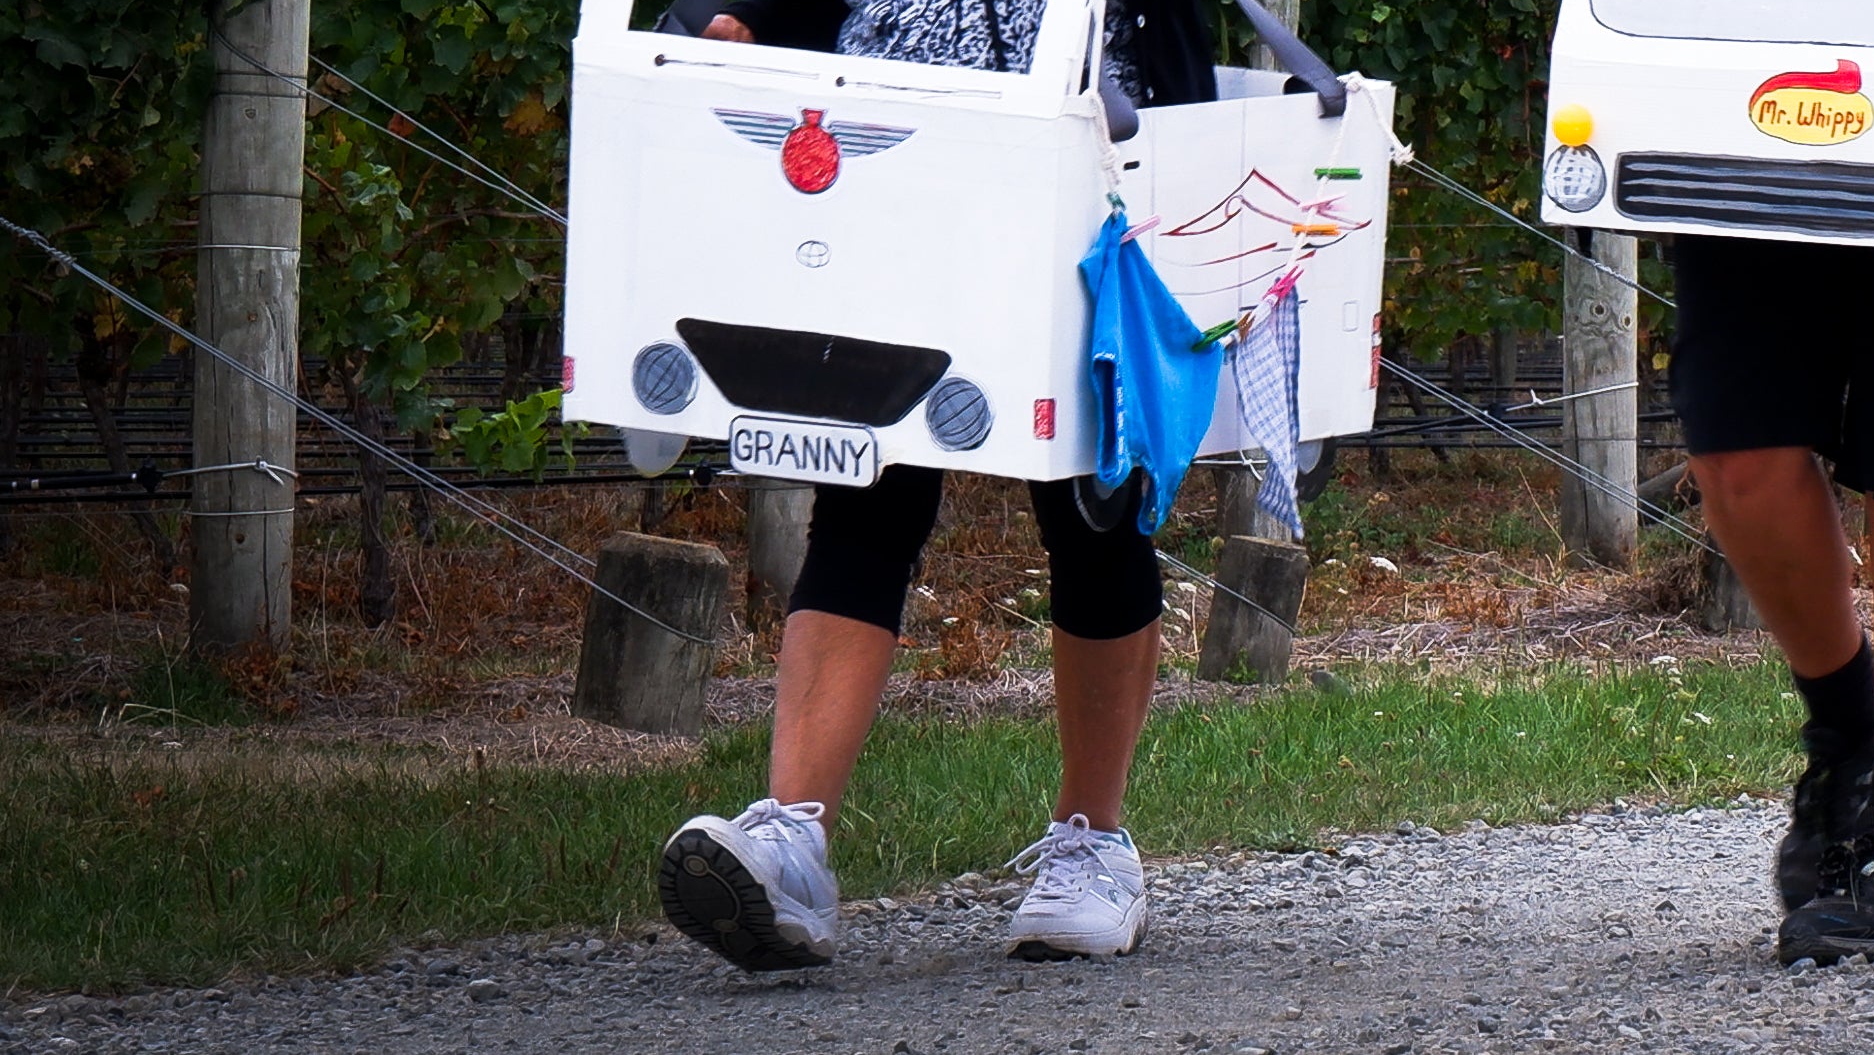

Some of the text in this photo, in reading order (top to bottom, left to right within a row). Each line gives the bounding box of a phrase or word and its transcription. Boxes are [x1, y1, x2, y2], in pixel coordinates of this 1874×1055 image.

[1758, 99, 1865, 138] Mr. Whippy
[734, 428, 871, 478] GRANNY
